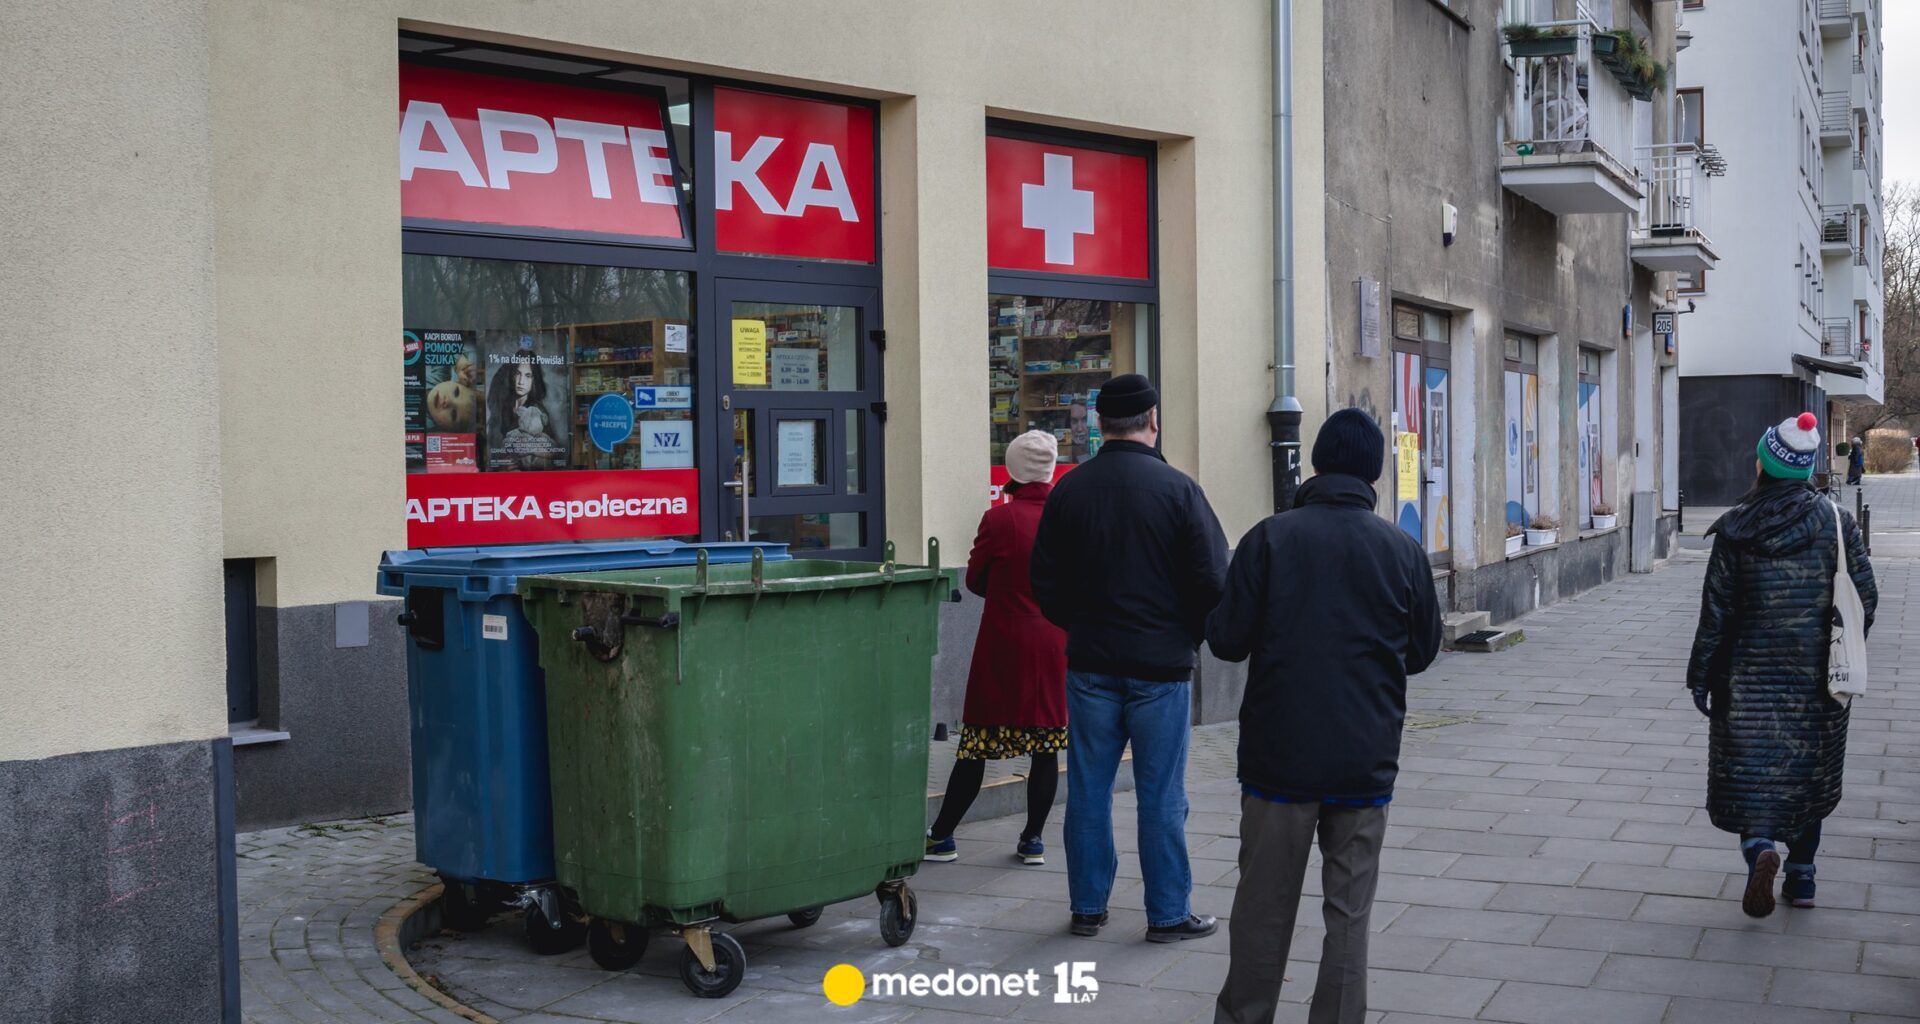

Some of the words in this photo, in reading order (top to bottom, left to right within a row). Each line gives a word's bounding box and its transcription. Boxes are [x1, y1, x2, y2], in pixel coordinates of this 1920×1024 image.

[1656, 320, 1672, 332] 205
[424, 342, 463, 353] POMOCY
[425, 354, 455, 365] SZUKA
[488, 353, 500, 364] 1%
[500, 355, 510, 364] na
[531, 357, 536, 365] z
[653, 432, 681, 447] NFZ
[406, 495, 543, 523] APTEKA
[548, 493, 688, 525] społeczna
